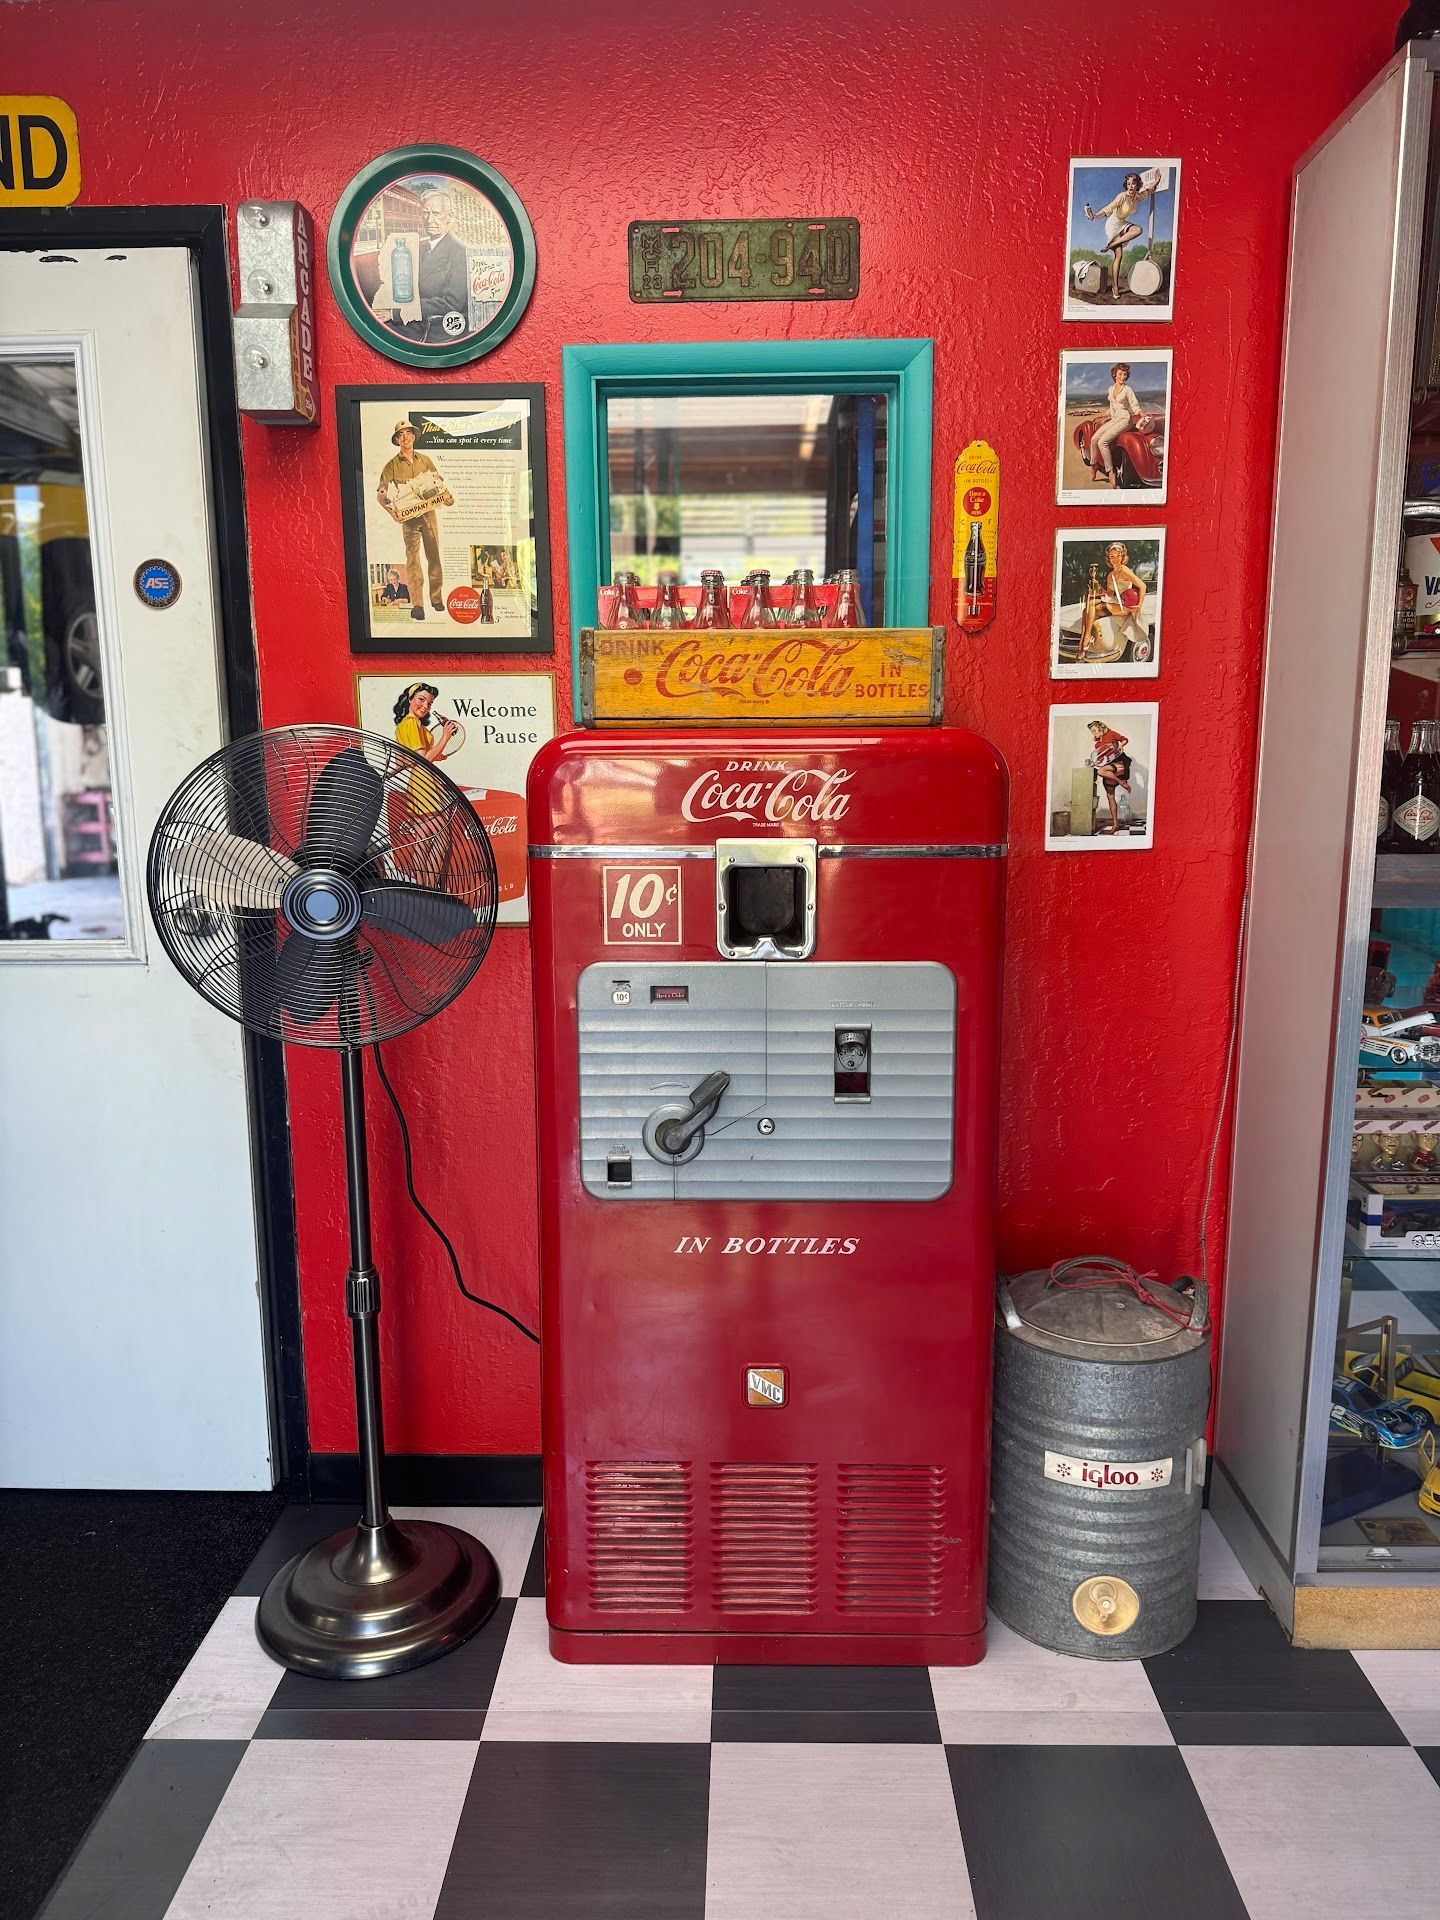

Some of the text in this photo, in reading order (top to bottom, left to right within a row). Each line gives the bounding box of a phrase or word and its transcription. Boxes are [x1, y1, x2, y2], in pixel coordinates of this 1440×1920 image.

[671, 229, 851, 289] 204-940
[473, 269, 505, 296] Coca-Cola
[643, 274, 662, 290] 23
[298, 209, 313, 383] ARCADE
[459, 436, 472, 446] spot
[474, 436, 480, 444] it
[480, 438, 497, 446] every
[498, 436, 513, 444] time
[956, 460, 1000, 475] Coca-Cola
[401, 502, 429, 518] COMPANY
[145, 577, 169, 589] ASE
[601, 639, 666, 657] DRINK
[656, 639, 863, 699] Coca-Cola
[879, 662, 902, 678] IN
[854, 683, 928, 699] BOTTLES
[452, 699, 537, 718] Welcome
[483, 725, 538, 744] Pause
[725, 761, 791, 772] DRINK
[681, 767, 858, 823] Coca-Cola
[610, 873, 680, 919] 10¢
[621, 922, 667, 938] ONLY
[673, 1237, 860, 1255] IN BOTTLES
[1059, 1362, 1083, 1373] DUTY
[1094, 1366, 1137, 1385] igloo
[751, 1374, 781, 1401] VMC
[1081, 1462, 1139, 1488] igloo
